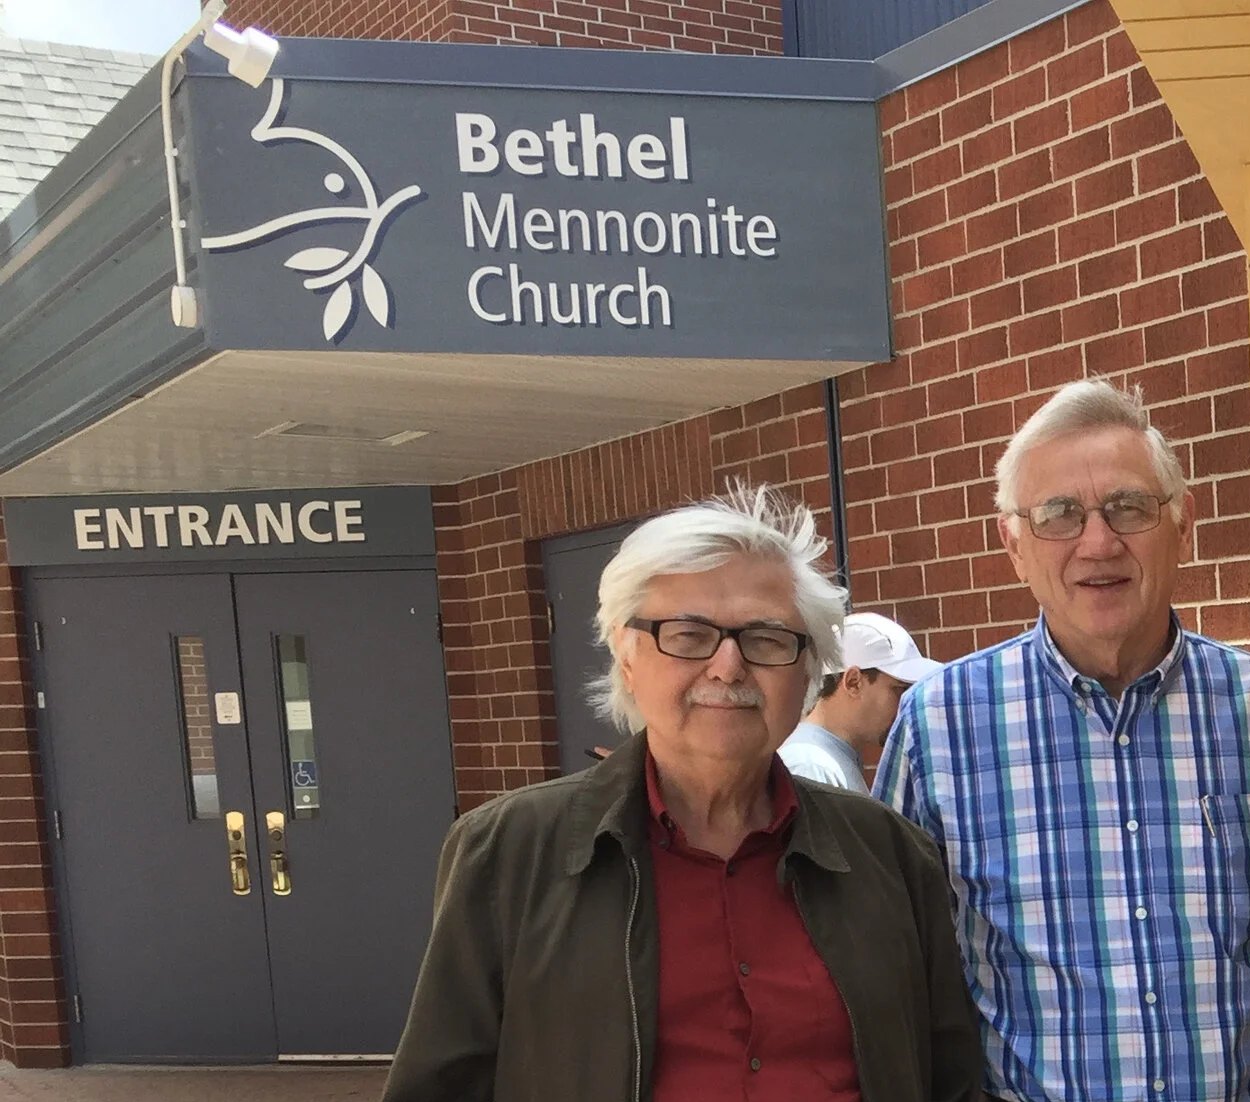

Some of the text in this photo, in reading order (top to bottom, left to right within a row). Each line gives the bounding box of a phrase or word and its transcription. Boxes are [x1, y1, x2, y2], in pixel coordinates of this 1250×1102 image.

[455, 112, 689, 180] Bethel
[462, 191, 777, 256] Mennonite
[467, 263, 671, 325] Church
[74, 500, 365, 550] ENTRANCE
